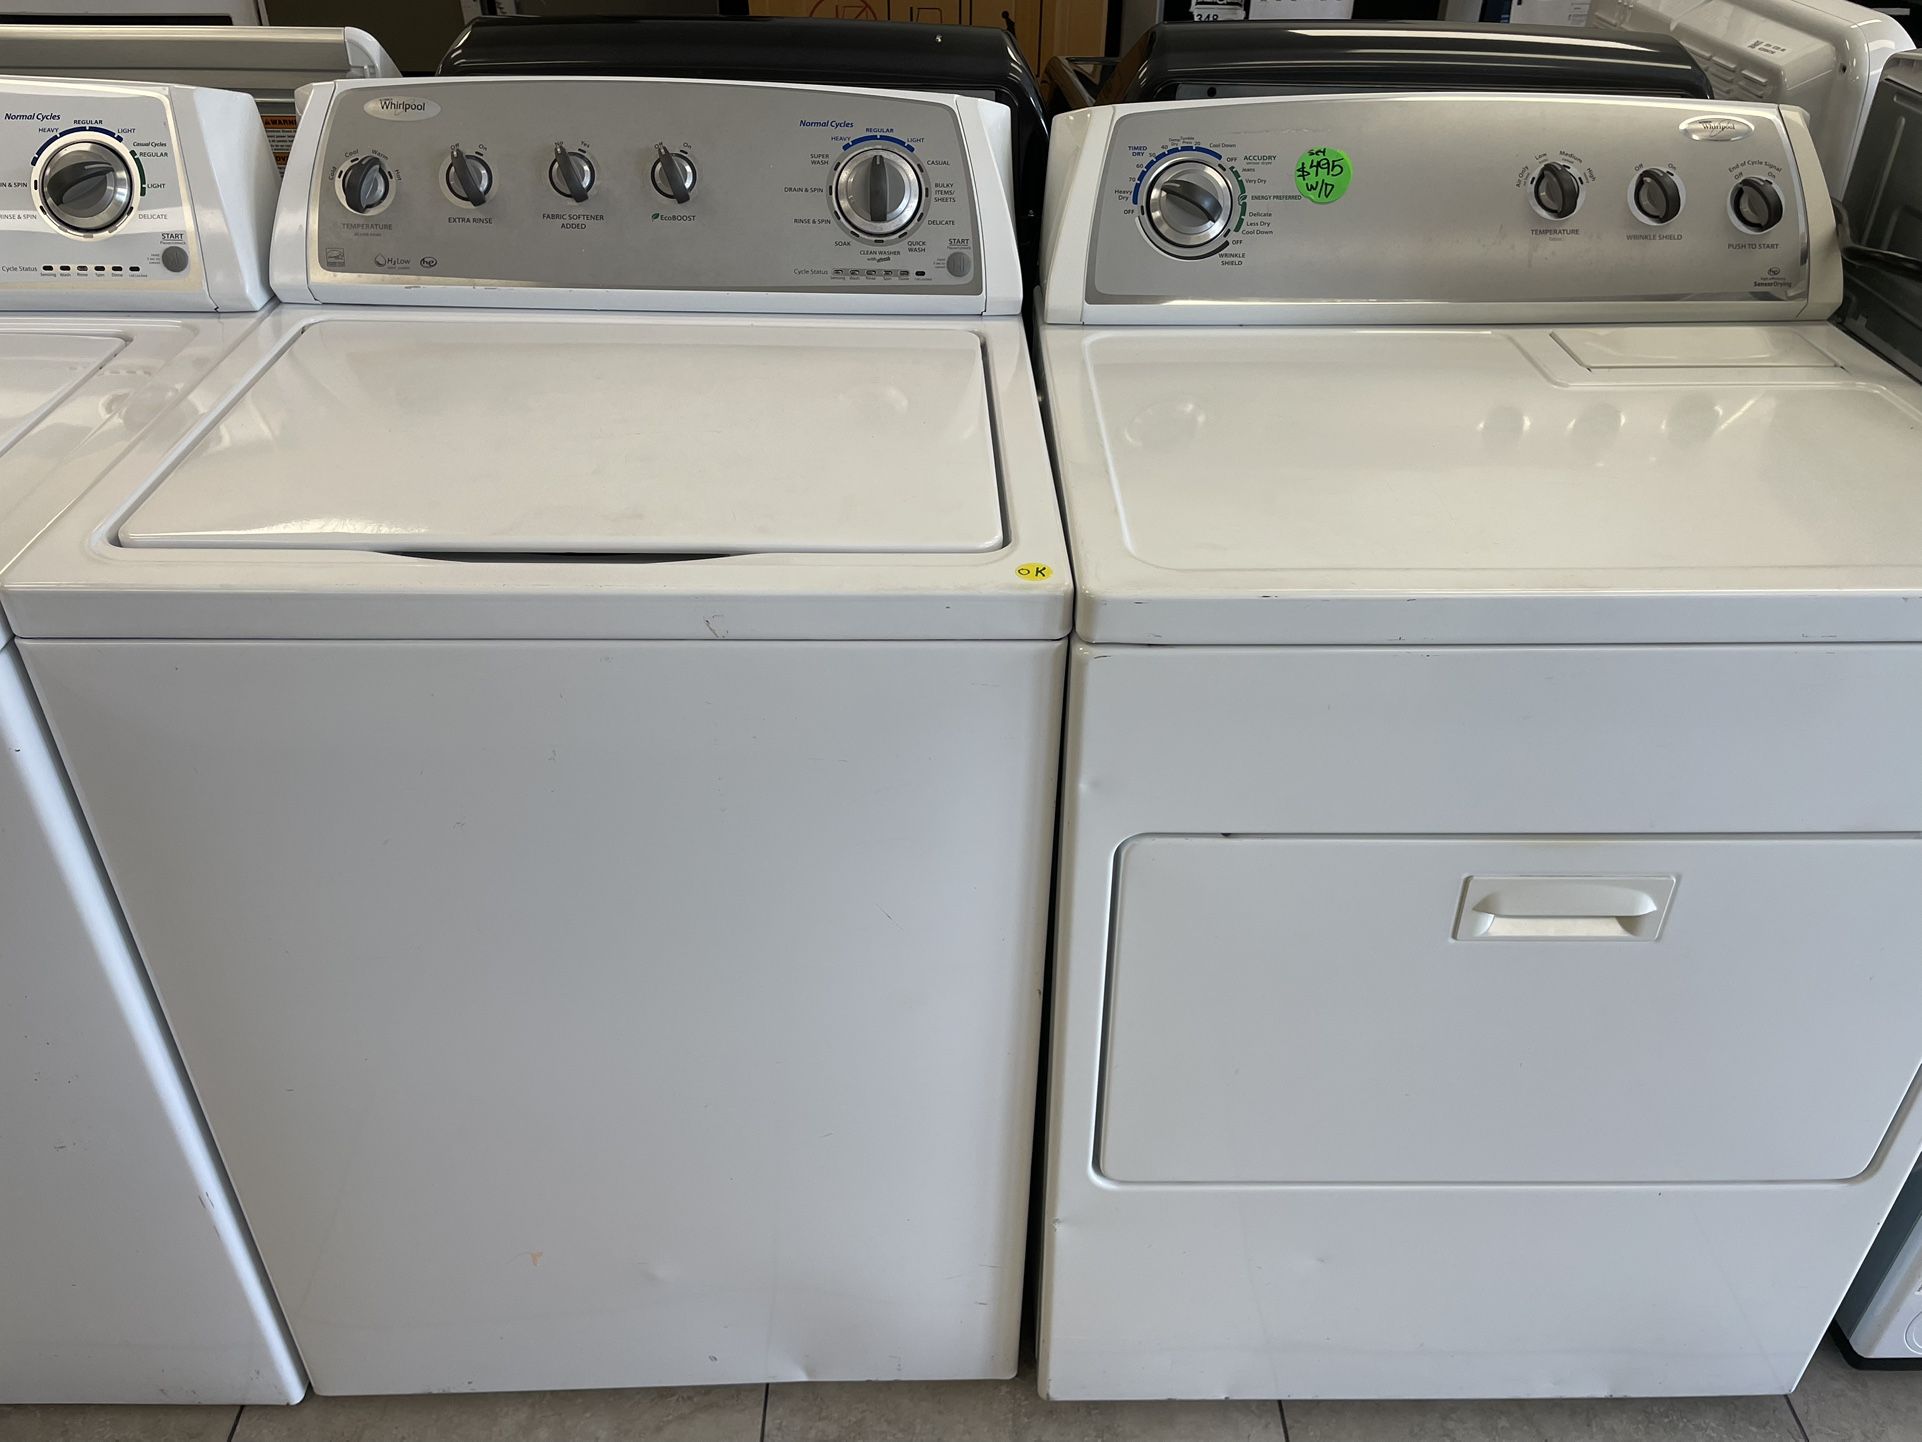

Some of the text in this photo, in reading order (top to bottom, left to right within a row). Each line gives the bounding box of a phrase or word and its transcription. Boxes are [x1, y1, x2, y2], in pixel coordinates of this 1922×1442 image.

[380, 99, 426, 112] Whirlpool
[36, 113, 60, 122] Cycles
[830, 120, 854, 129] Cycles
[1703, 123, 1736, 133] Whirlpool
[345, 149, 359, 158] Cool
[371, 150, 388, 160] Warm
[1535, 152, 1547, 161] Low
[1560, 150, 1583, 163] Medium
[1296, 158, 1344, 181] $495
[1519, 165, 1528, 178] Only
[1634, 163, 1644, 172] Off
[1728, 164, 1741, 173] End
[1764, 161, 1782, 173] Signal
[1586, 168, 1596, 182] High
[1734, 171, 1744, 180] Off
